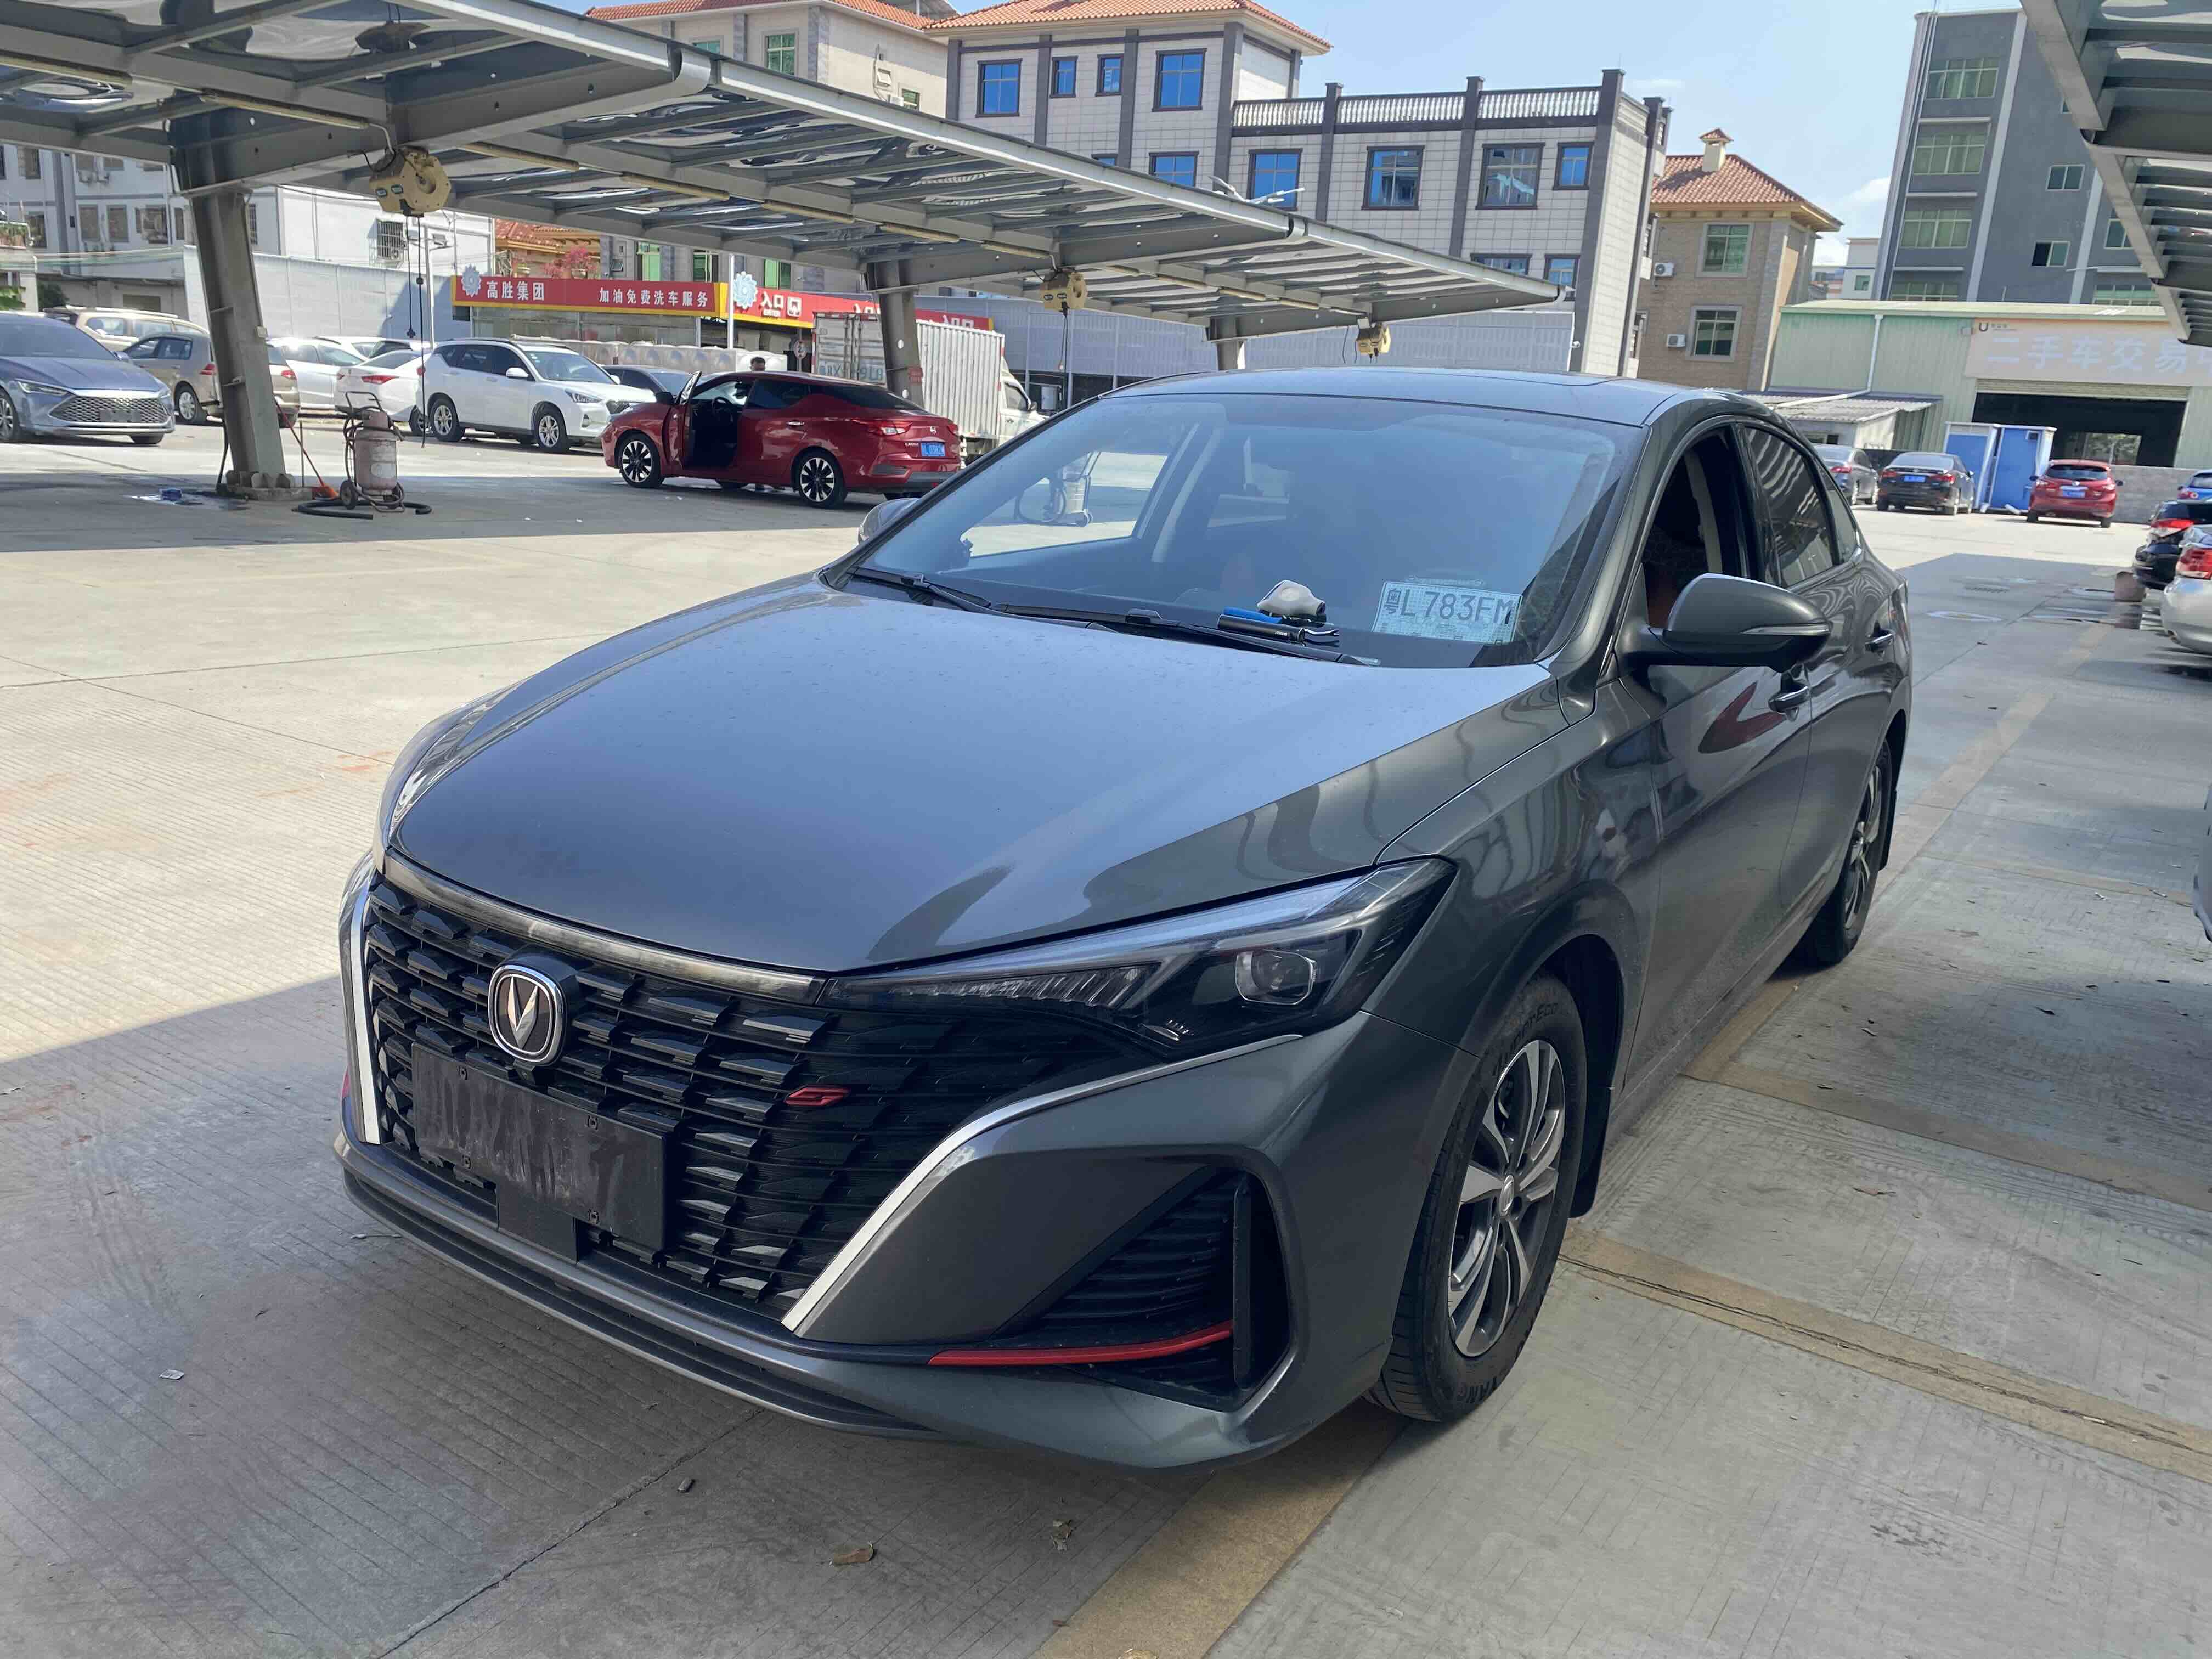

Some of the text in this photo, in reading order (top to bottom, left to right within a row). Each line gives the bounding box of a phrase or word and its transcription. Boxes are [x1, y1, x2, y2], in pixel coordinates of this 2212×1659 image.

[487, 280, 545, 302] 高胜集团
[599, 287, 708, 307] 加油免费洗车服务
[760, 290, 784, 309] 入口
